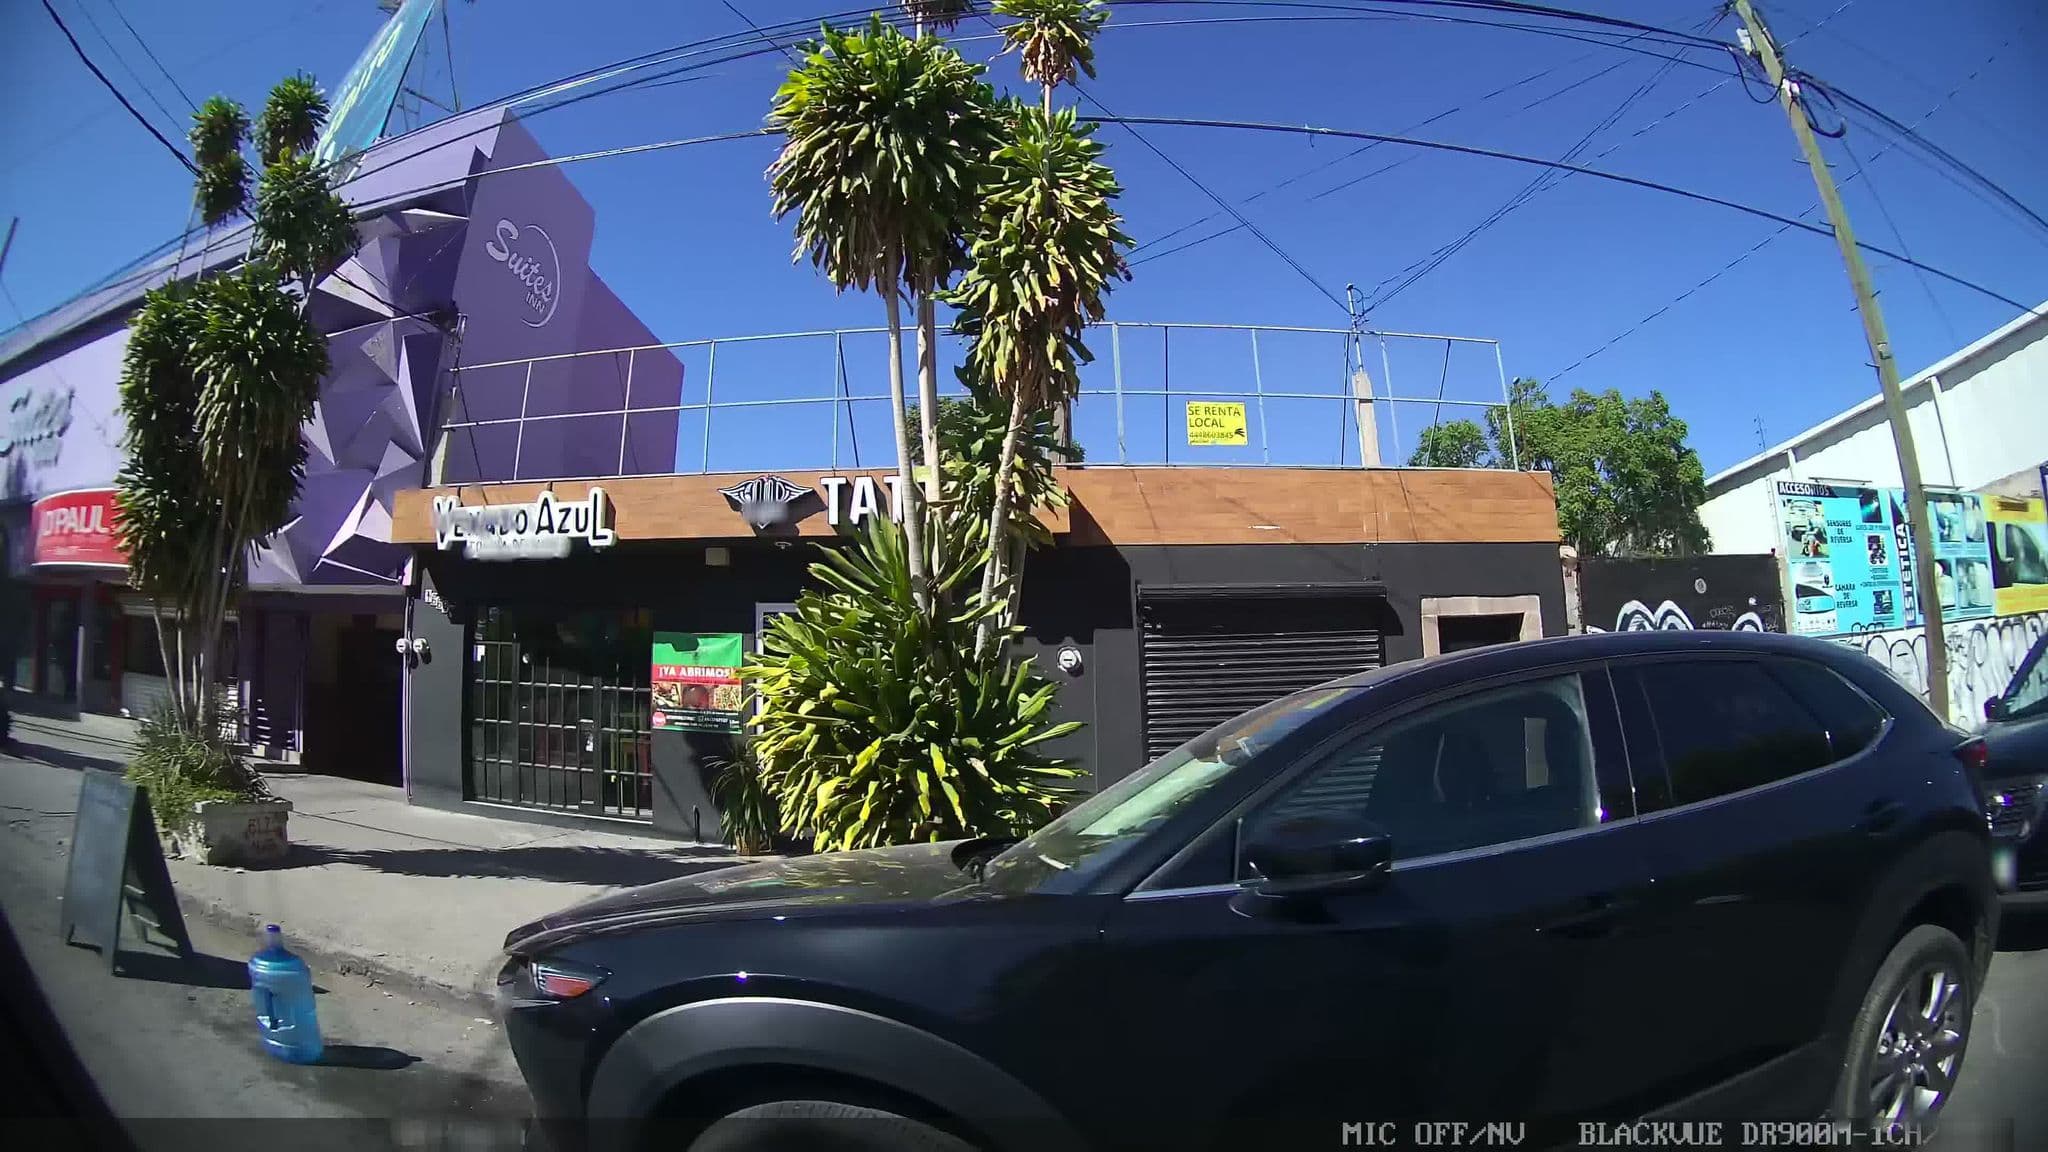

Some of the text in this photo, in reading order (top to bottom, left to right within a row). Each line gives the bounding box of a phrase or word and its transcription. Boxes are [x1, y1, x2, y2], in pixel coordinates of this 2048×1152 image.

[486, 218, 552, 302] Suites
[526, 292, 545, 313] INN
[1188, 405, 1241, 417] SE RENTA
[1189, 417, 1225, 428] LOCAL
